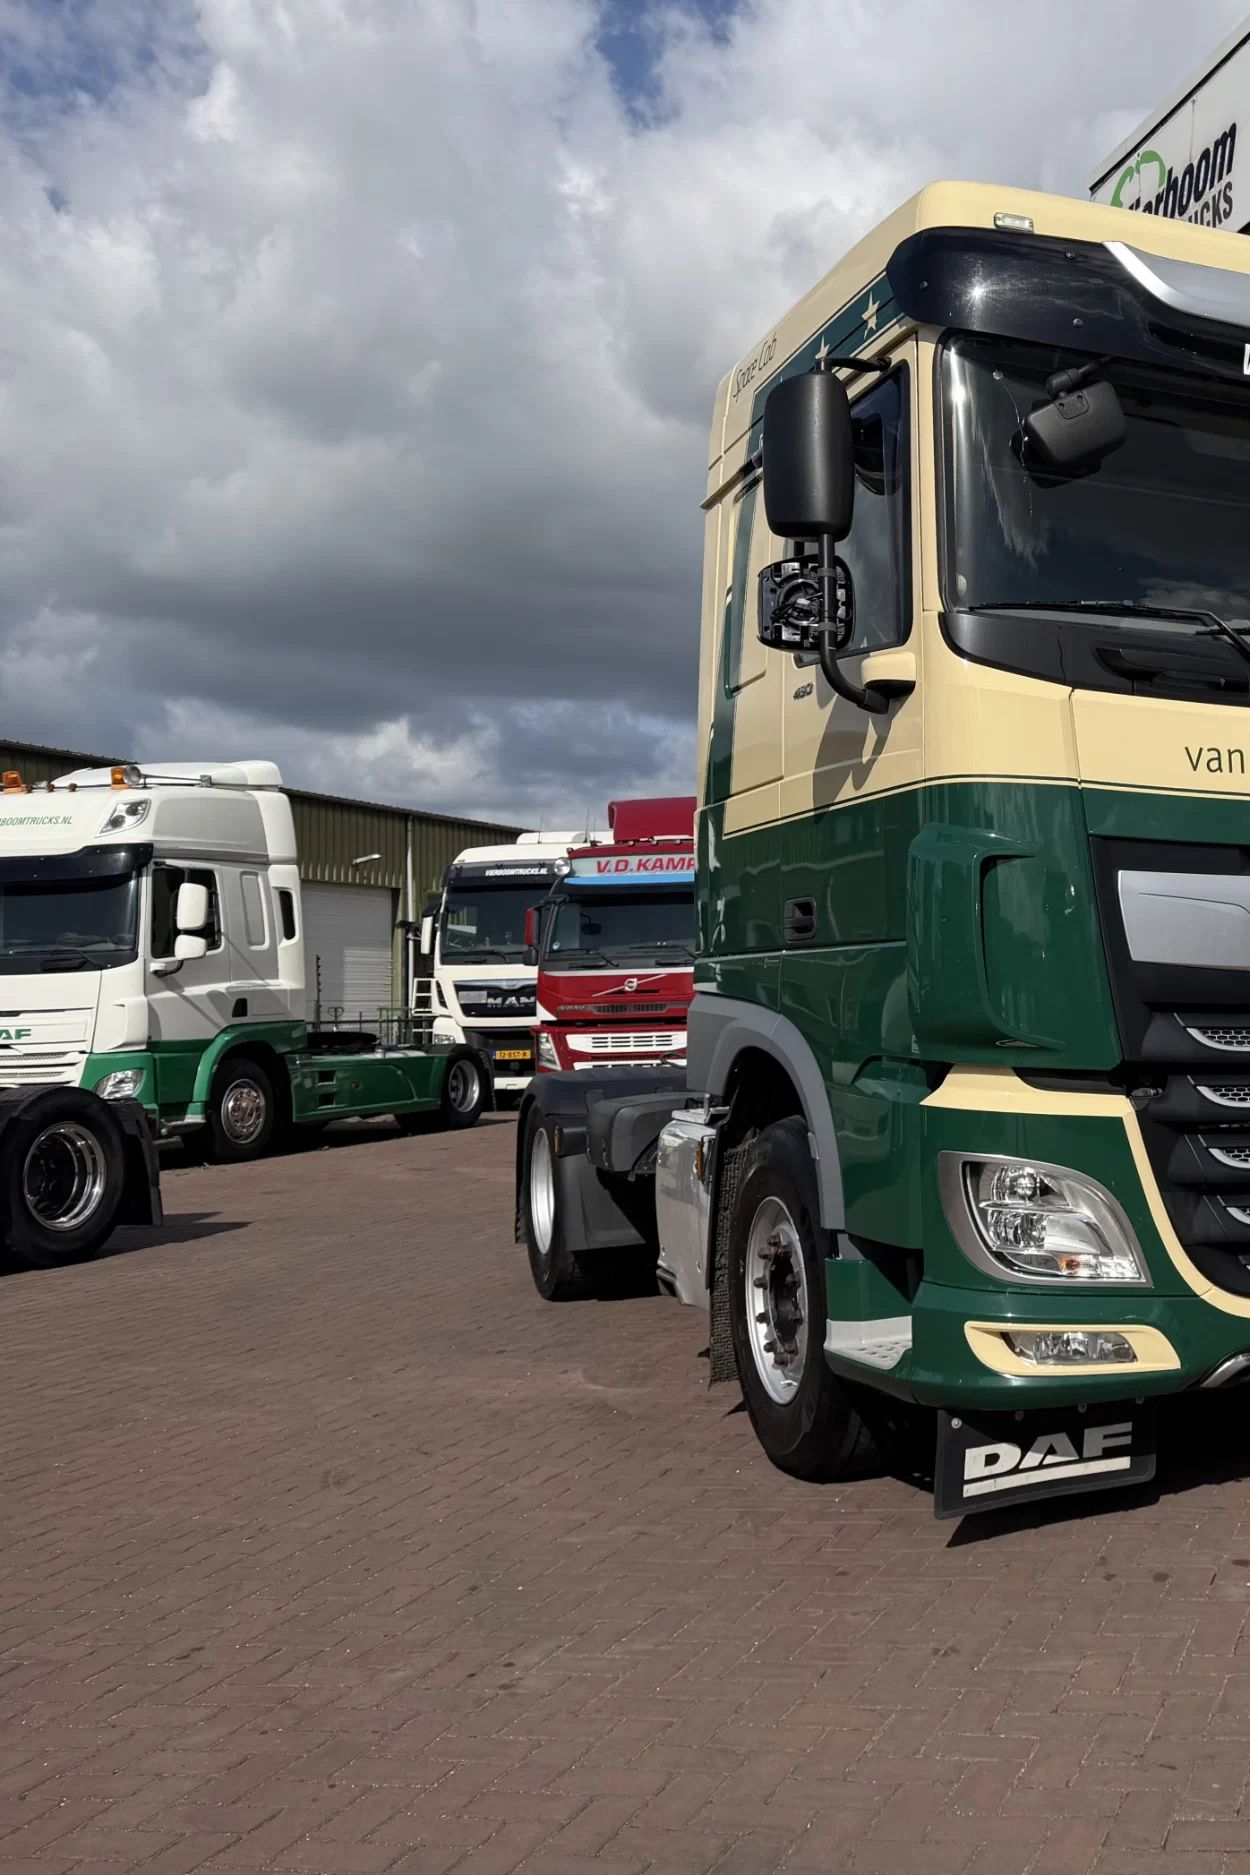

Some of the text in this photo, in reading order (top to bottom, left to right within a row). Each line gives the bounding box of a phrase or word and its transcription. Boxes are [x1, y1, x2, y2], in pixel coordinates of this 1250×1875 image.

[1128, 122, 1237, 219] rboom
[1184, 746, 1245, 774] van
[0, 816, 73, 827] BOOMTRUCKS.NL
[487, 996, 536, 1008] MAN
[964, 1421, 1133, 1481] DAF
